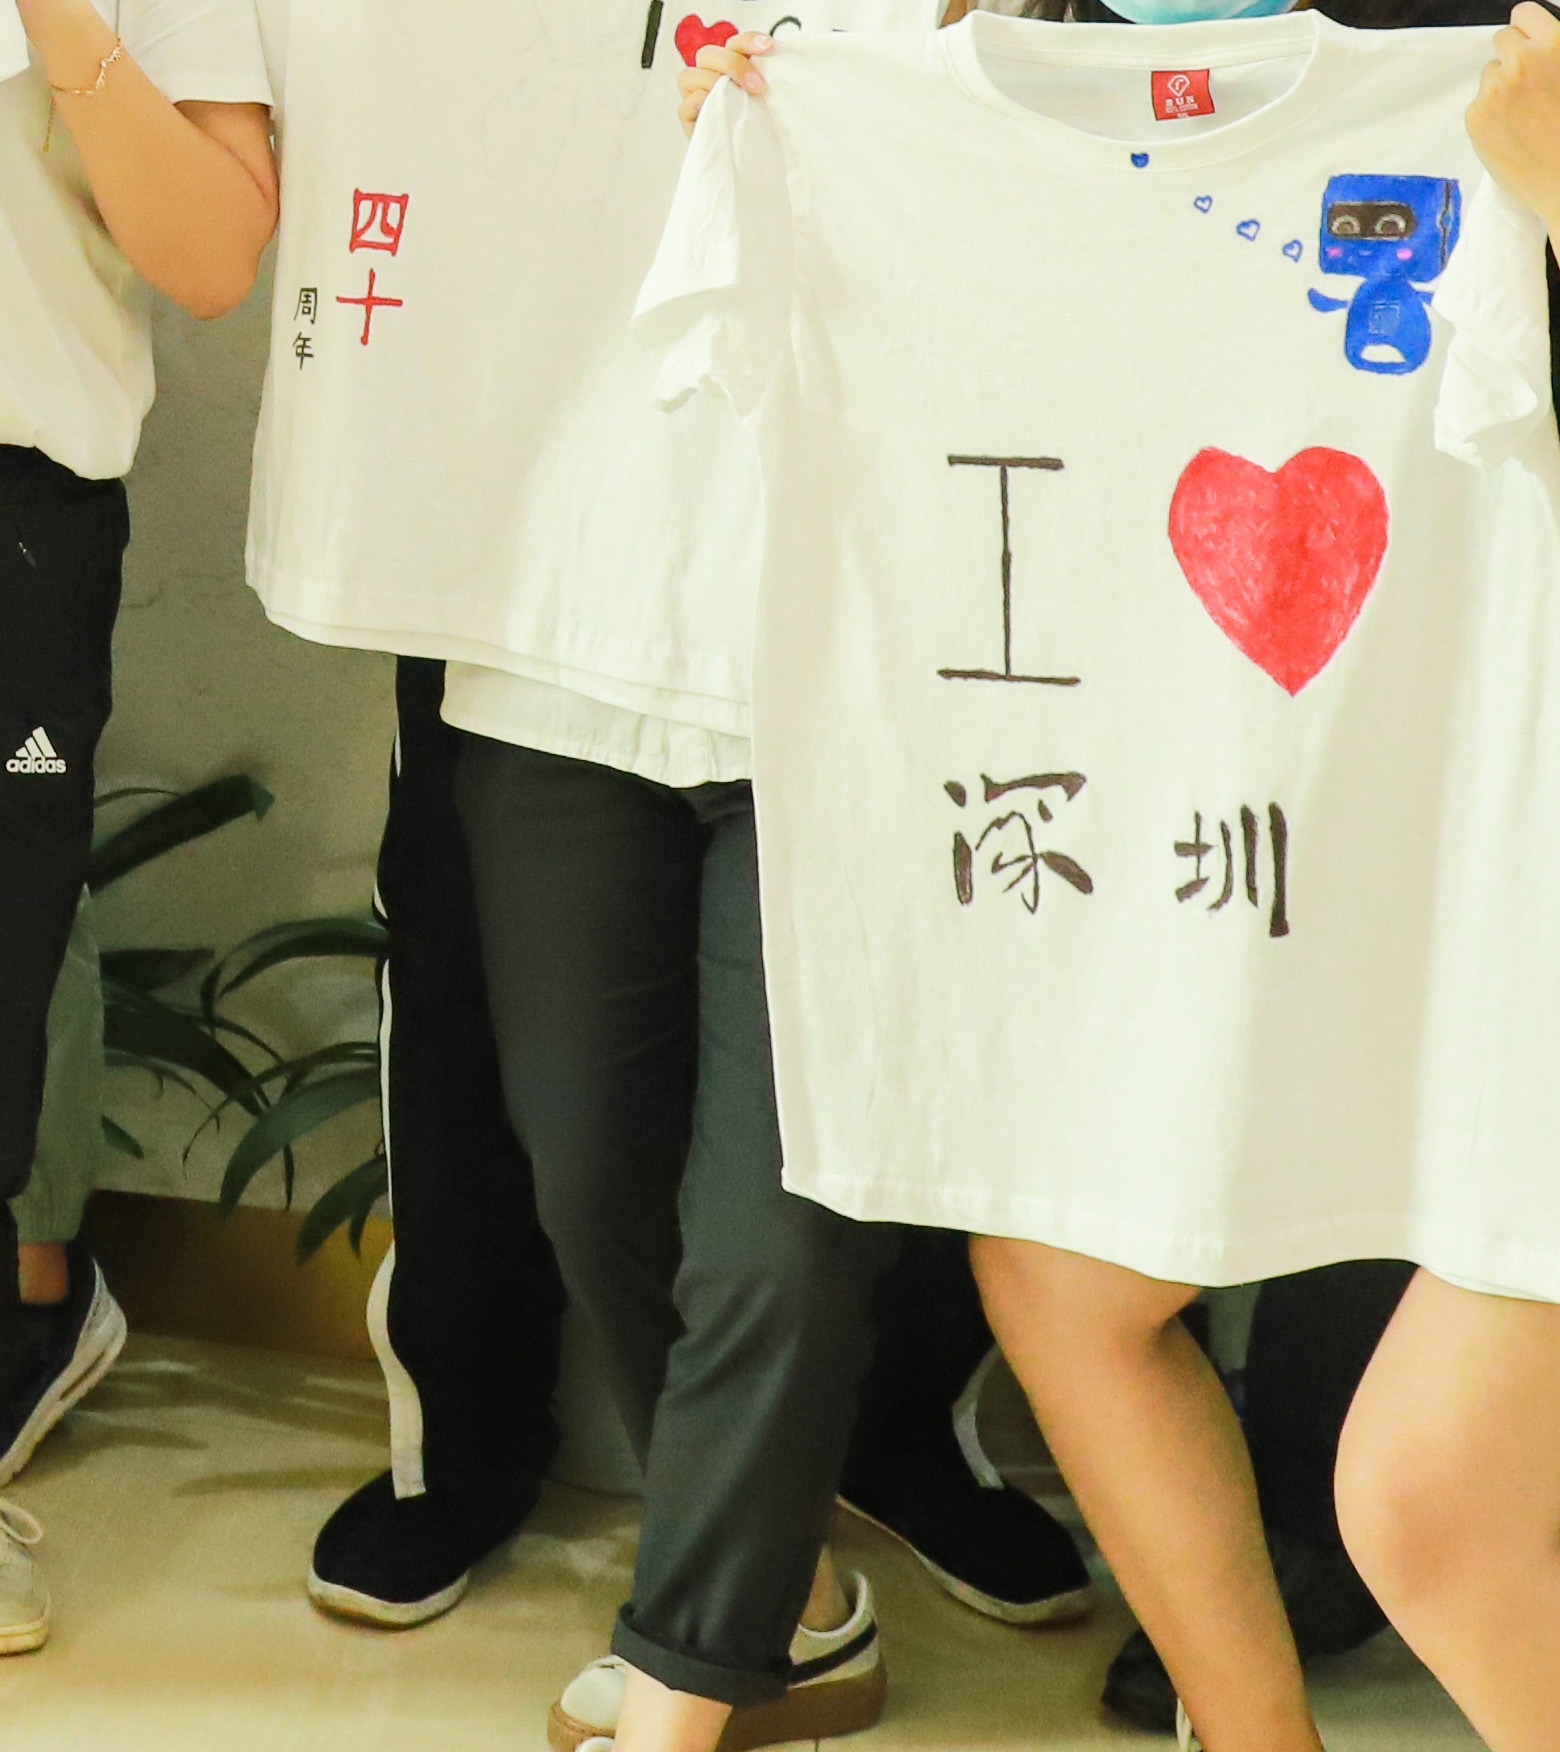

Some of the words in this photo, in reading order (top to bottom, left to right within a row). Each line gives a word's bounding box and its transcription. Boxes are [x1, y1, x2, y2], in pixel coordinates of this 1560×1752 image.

[335, 187, 410, 346] 四十
[292, 286, 320, 372] 周年
[5, 756, 67, 774] adidas
[943, 770, 1291, 938] 深圳
